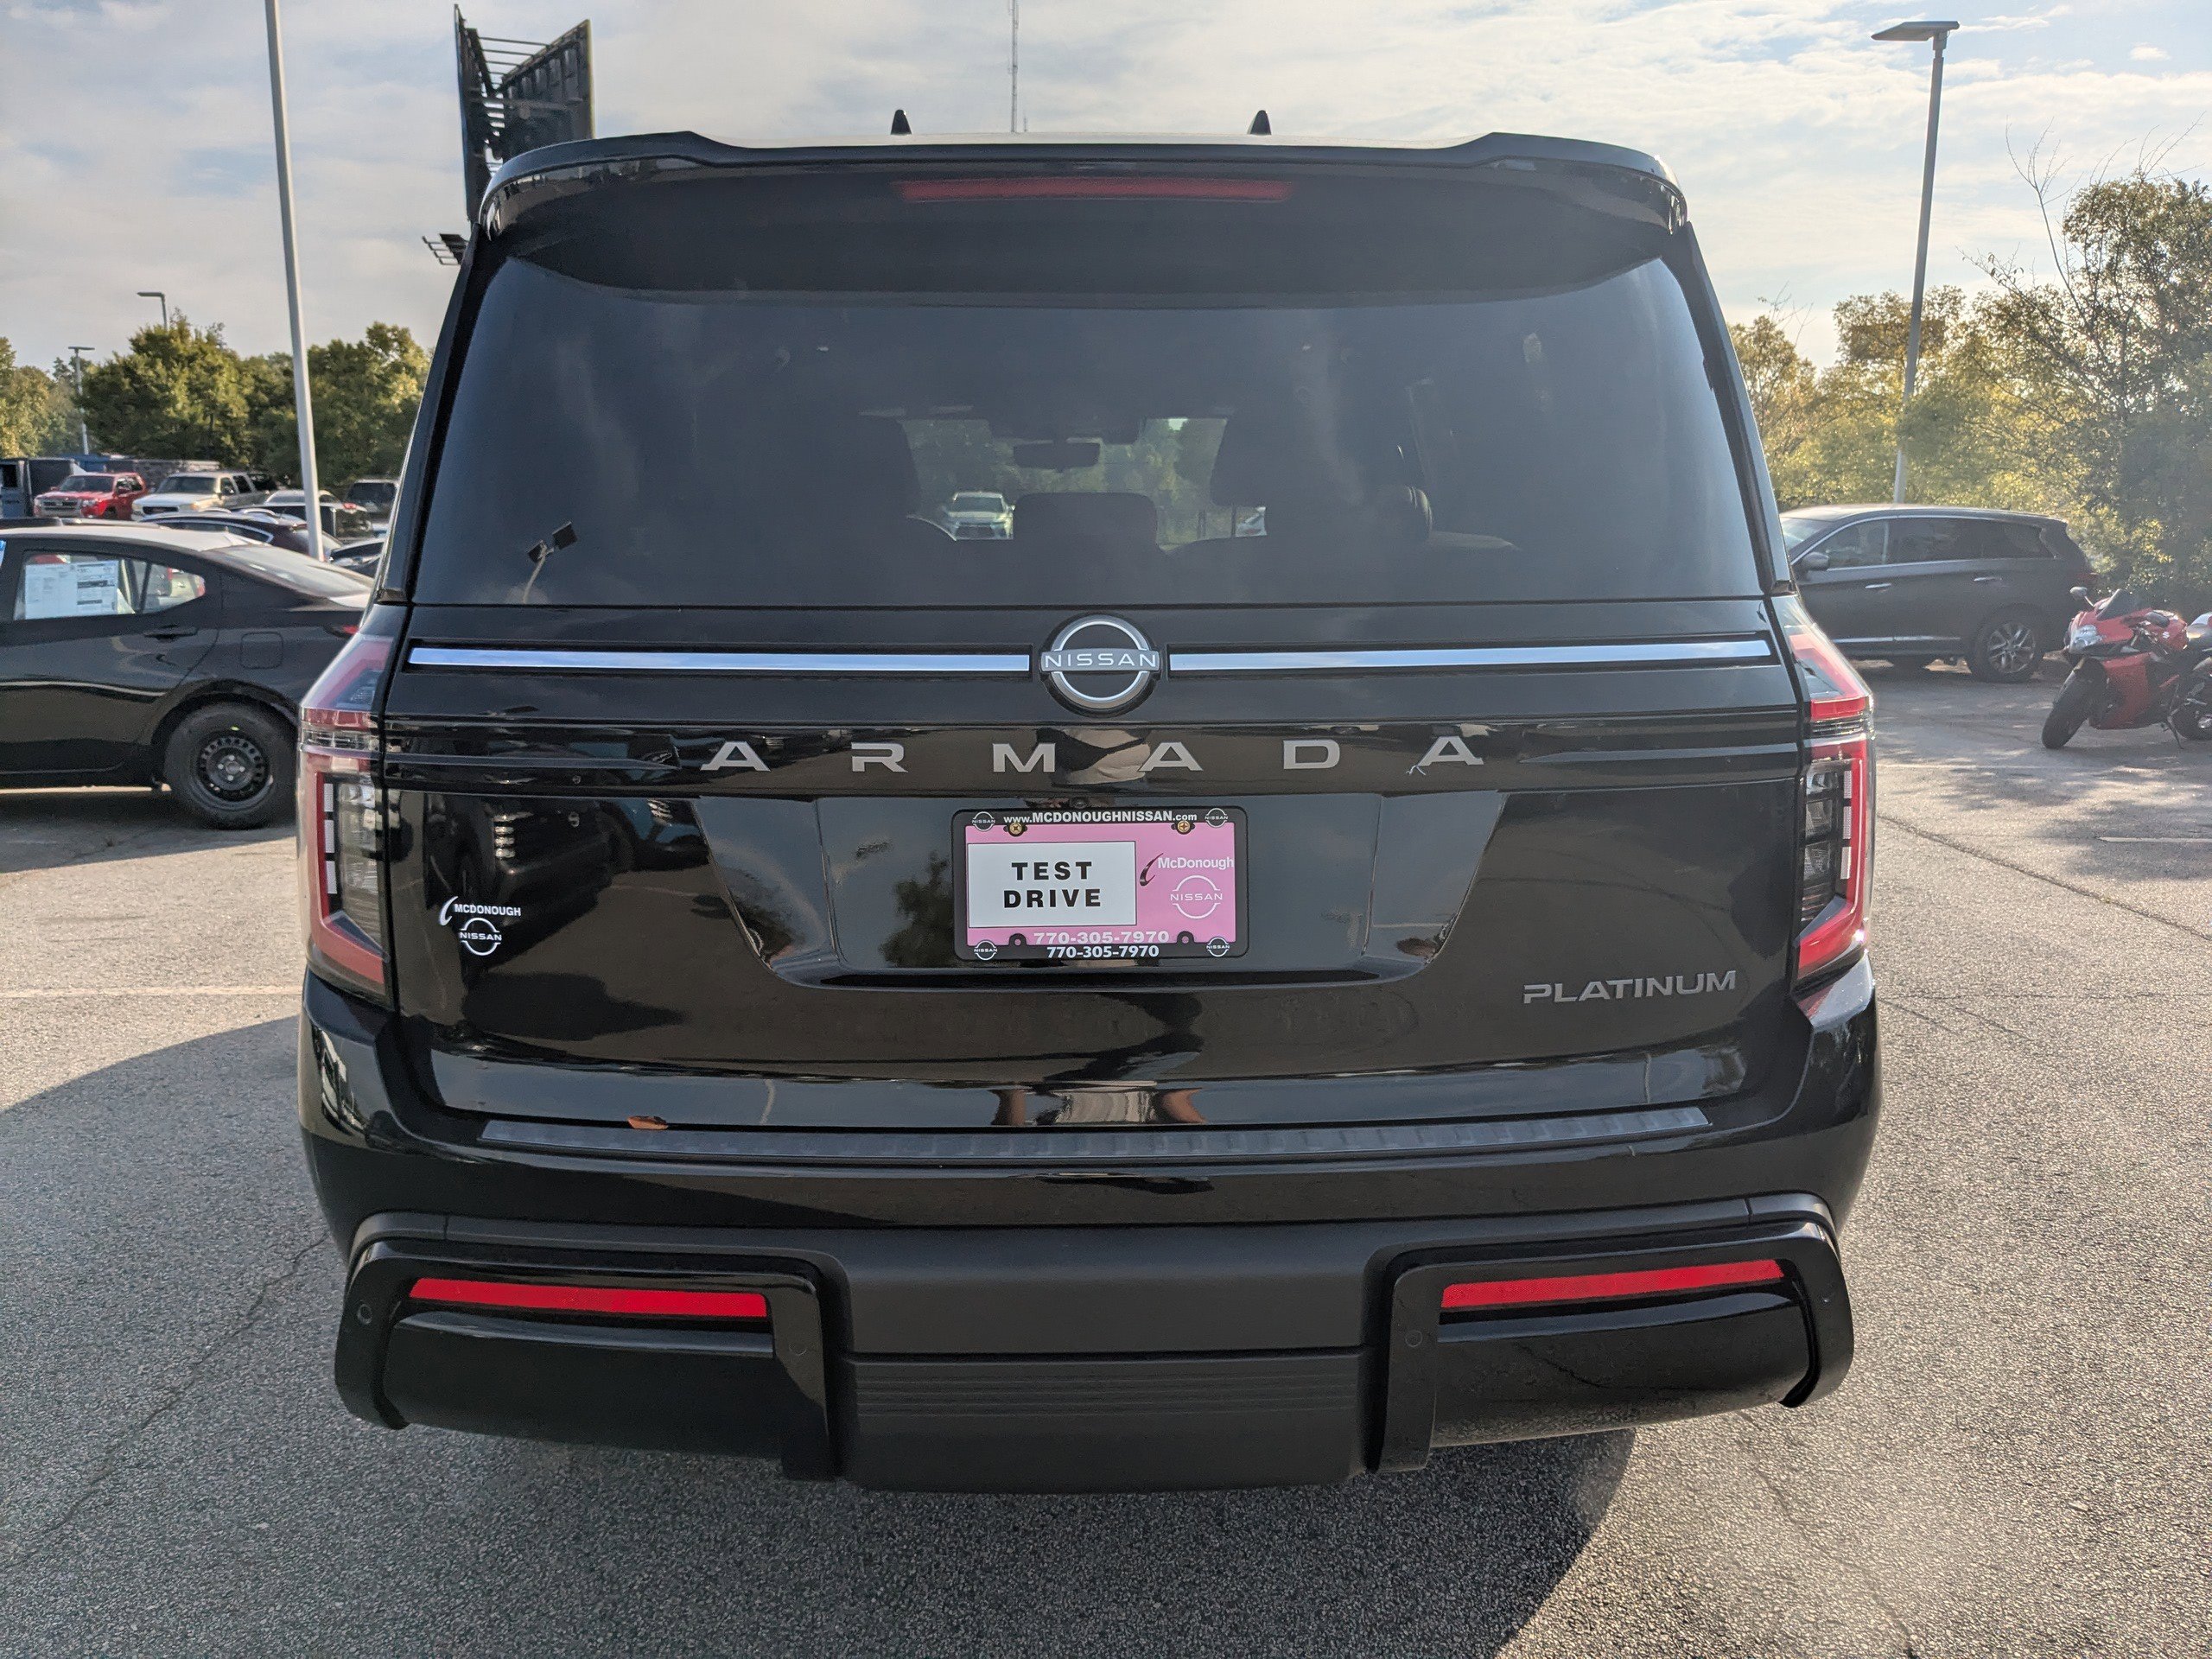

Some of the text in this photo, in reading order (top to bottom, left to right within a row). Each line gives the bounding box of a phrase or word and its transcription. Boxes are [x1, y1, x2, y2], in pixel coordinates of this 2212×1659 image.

[1045, 653, 1156, 668] NISSAN
[700, 734, 1484, 773] ARMADA
[1003, 810, 1198, 823] www.MCDONOUGHNISSAN.com
[1158, 856, 1234, 870] McDonough
[1011, 861, 1092, 881] TEST
[1003, 888, 1101, 909] DRIVE
[1170, 893, 1224, 901] NISSAN
[453, 903, 522, 917] MCDONOUGH
[459, 931, 503, 941] NISSAN
[1033, 930, 1170, 945] 770-305-7970
[1046, 944, 1160, 958] 770-305-7970
[1523, 969, 1737, 1004] PLATINUM
